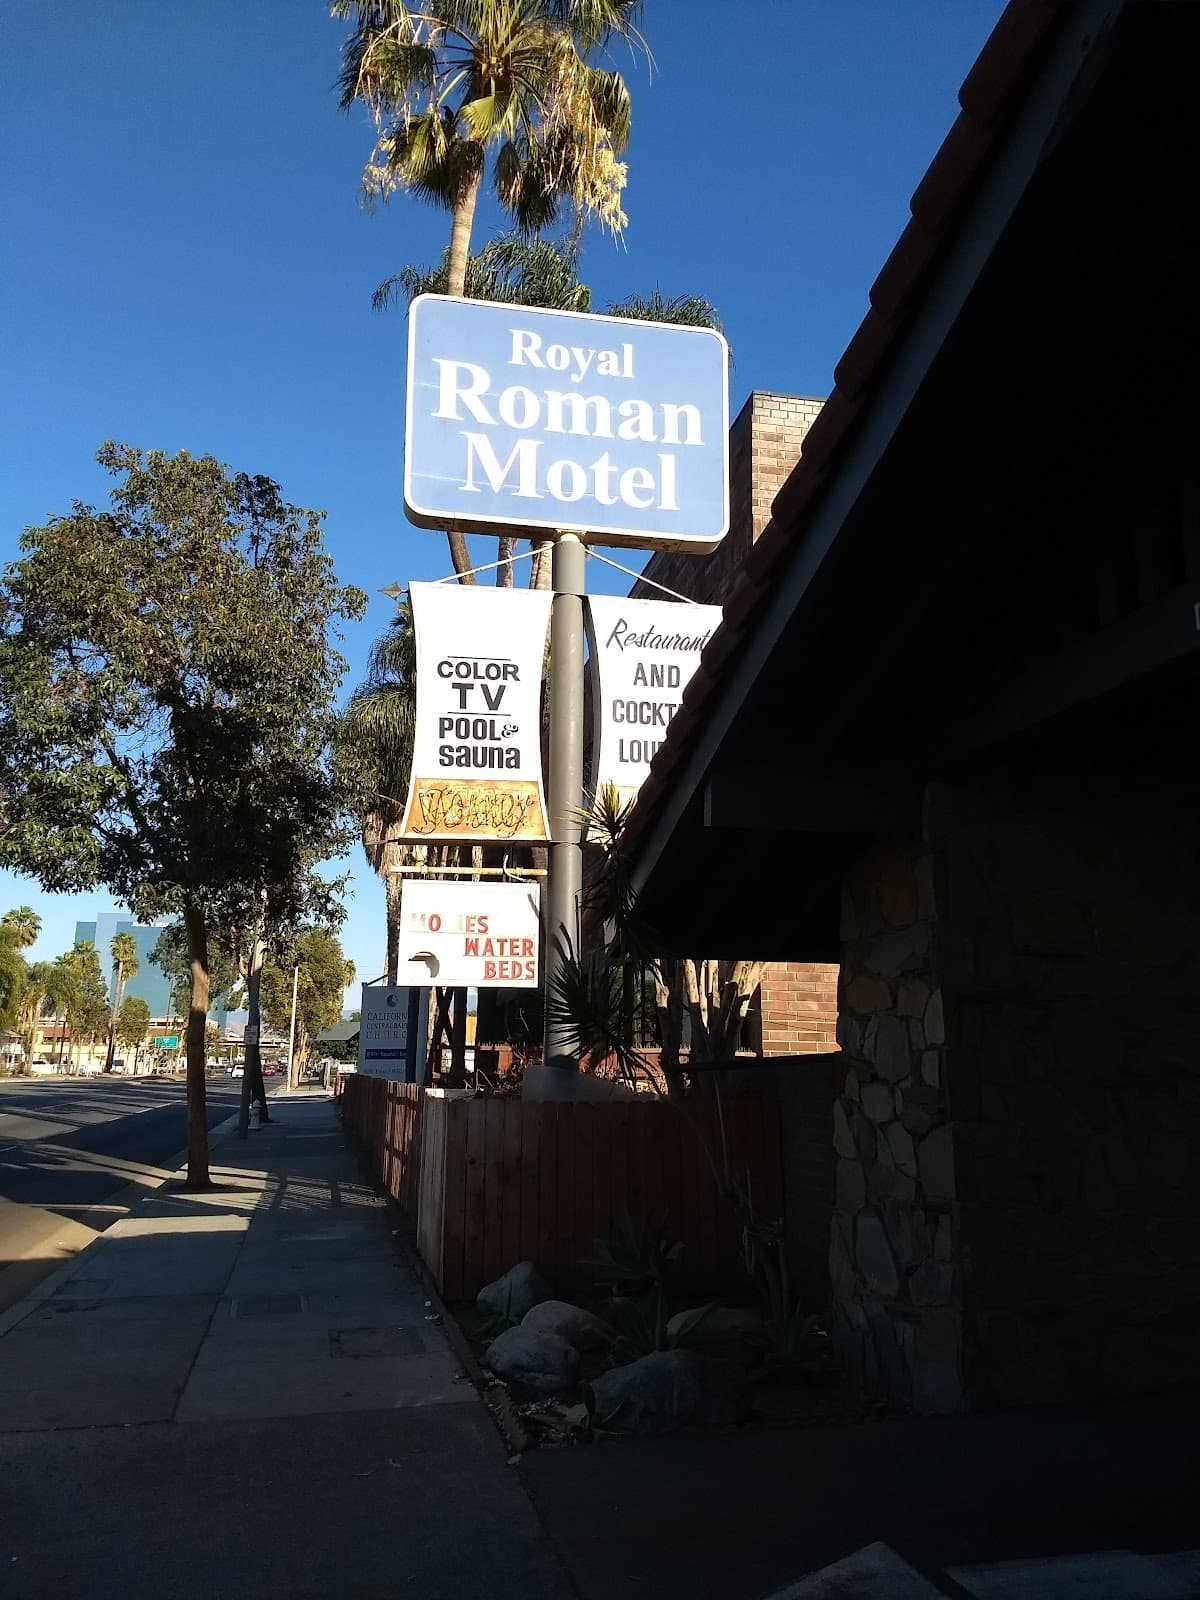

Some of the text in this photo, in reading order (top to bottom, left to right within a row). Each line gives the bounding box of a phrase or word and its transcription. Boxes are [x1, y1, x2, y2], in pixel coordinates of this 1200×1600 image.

[508, 328, 635, 382] Royal
[430, 357, 705, 446] Roman
[458, 431, 681, 511] Motel
[605, 617, 712, 652] Restaurant
[436, 659, 521, 682] COLOR
[633, 662, 681, 689] AND
[451, 682, 507, 711] TV
[612, 698, 680, 726] COCKT
[438, 744, 521, 769] sauna
[463, 937, 534, 957] WATER
[483, 960, 535, 981] BEDS
